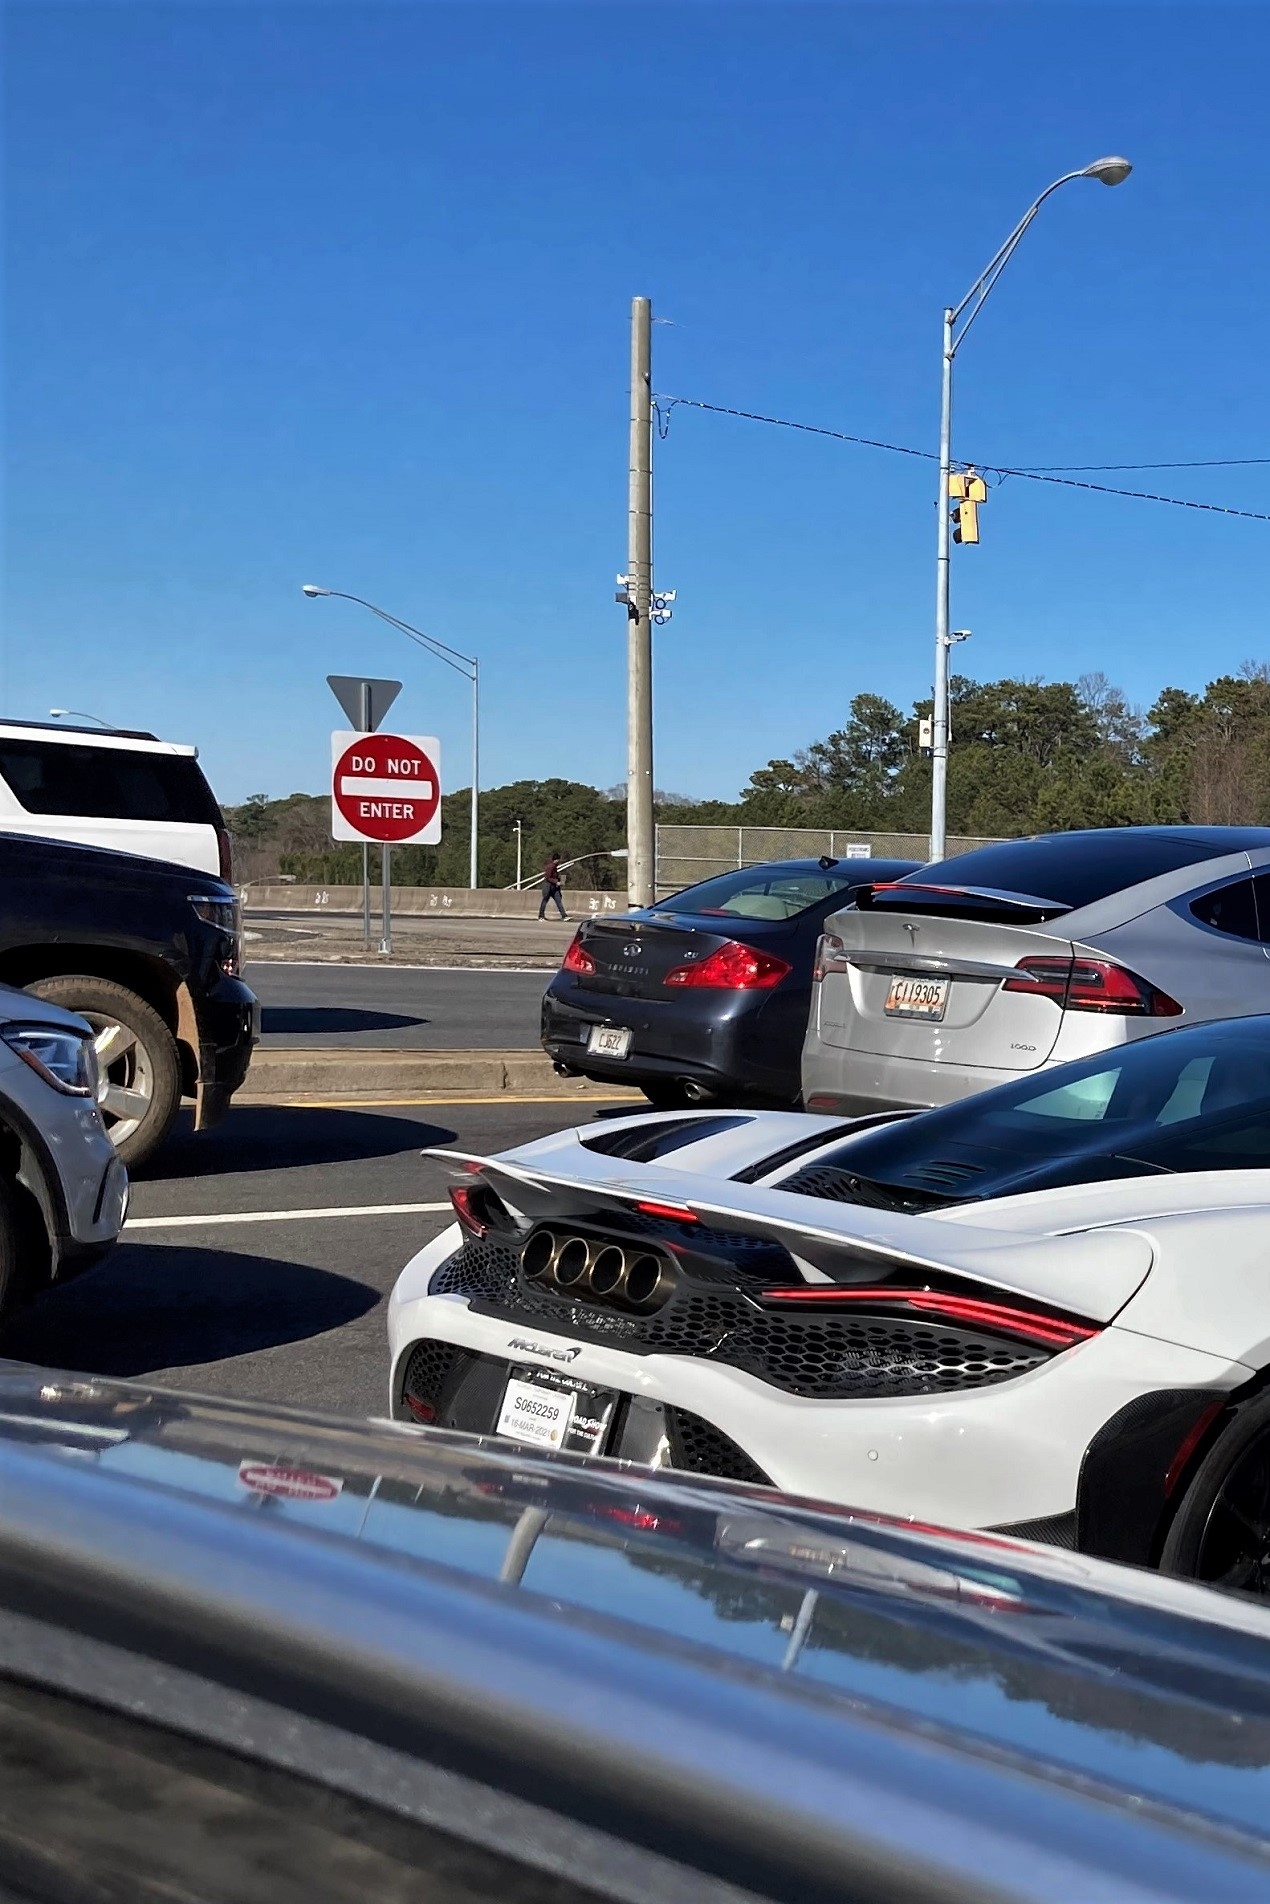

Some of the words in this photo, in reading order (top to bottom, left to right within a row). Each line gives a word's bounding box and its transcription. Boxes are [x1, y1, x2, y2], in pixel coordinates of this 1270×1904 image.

[351, 755, 376, 773] DO
[387, 758, 422, 775] NOT
[359, 802, 414, 820] ENTER
[514, 1396, 560, 1421] S0652259
